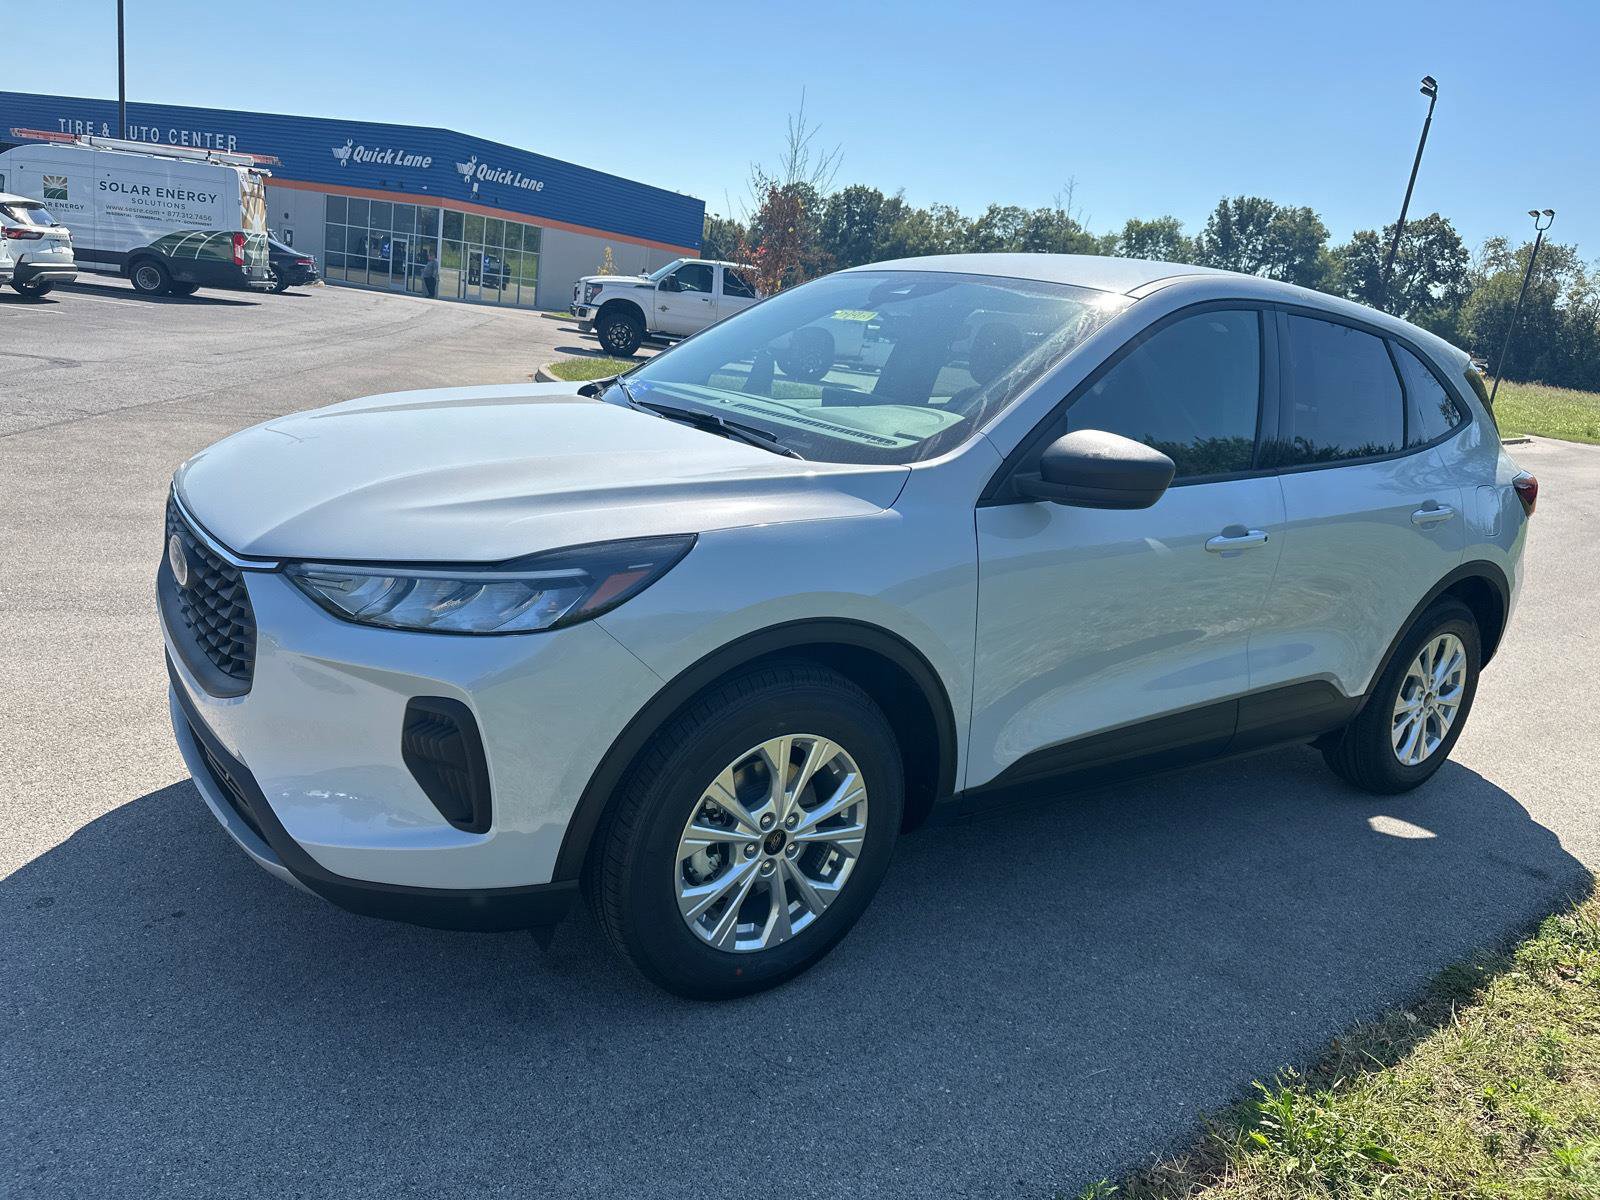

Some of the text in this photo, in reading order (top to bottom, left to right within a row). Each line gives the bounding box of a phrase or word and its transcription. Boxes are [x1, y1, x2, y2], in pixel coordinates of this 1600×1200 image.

[58, 118, 238, 151] TIRE & UTO CENTER
[353, 145, 433, 168] Quick Lane
[476, 163, 545, 192] Quick Lane
[99, 180, 218, 204] SOLAR ENERGY
[131, 197, 186, 210] SOLUTIONS
[54, 202, 85, 210] ENERGY
[105, 204, 160, 216] www.sesre.com
